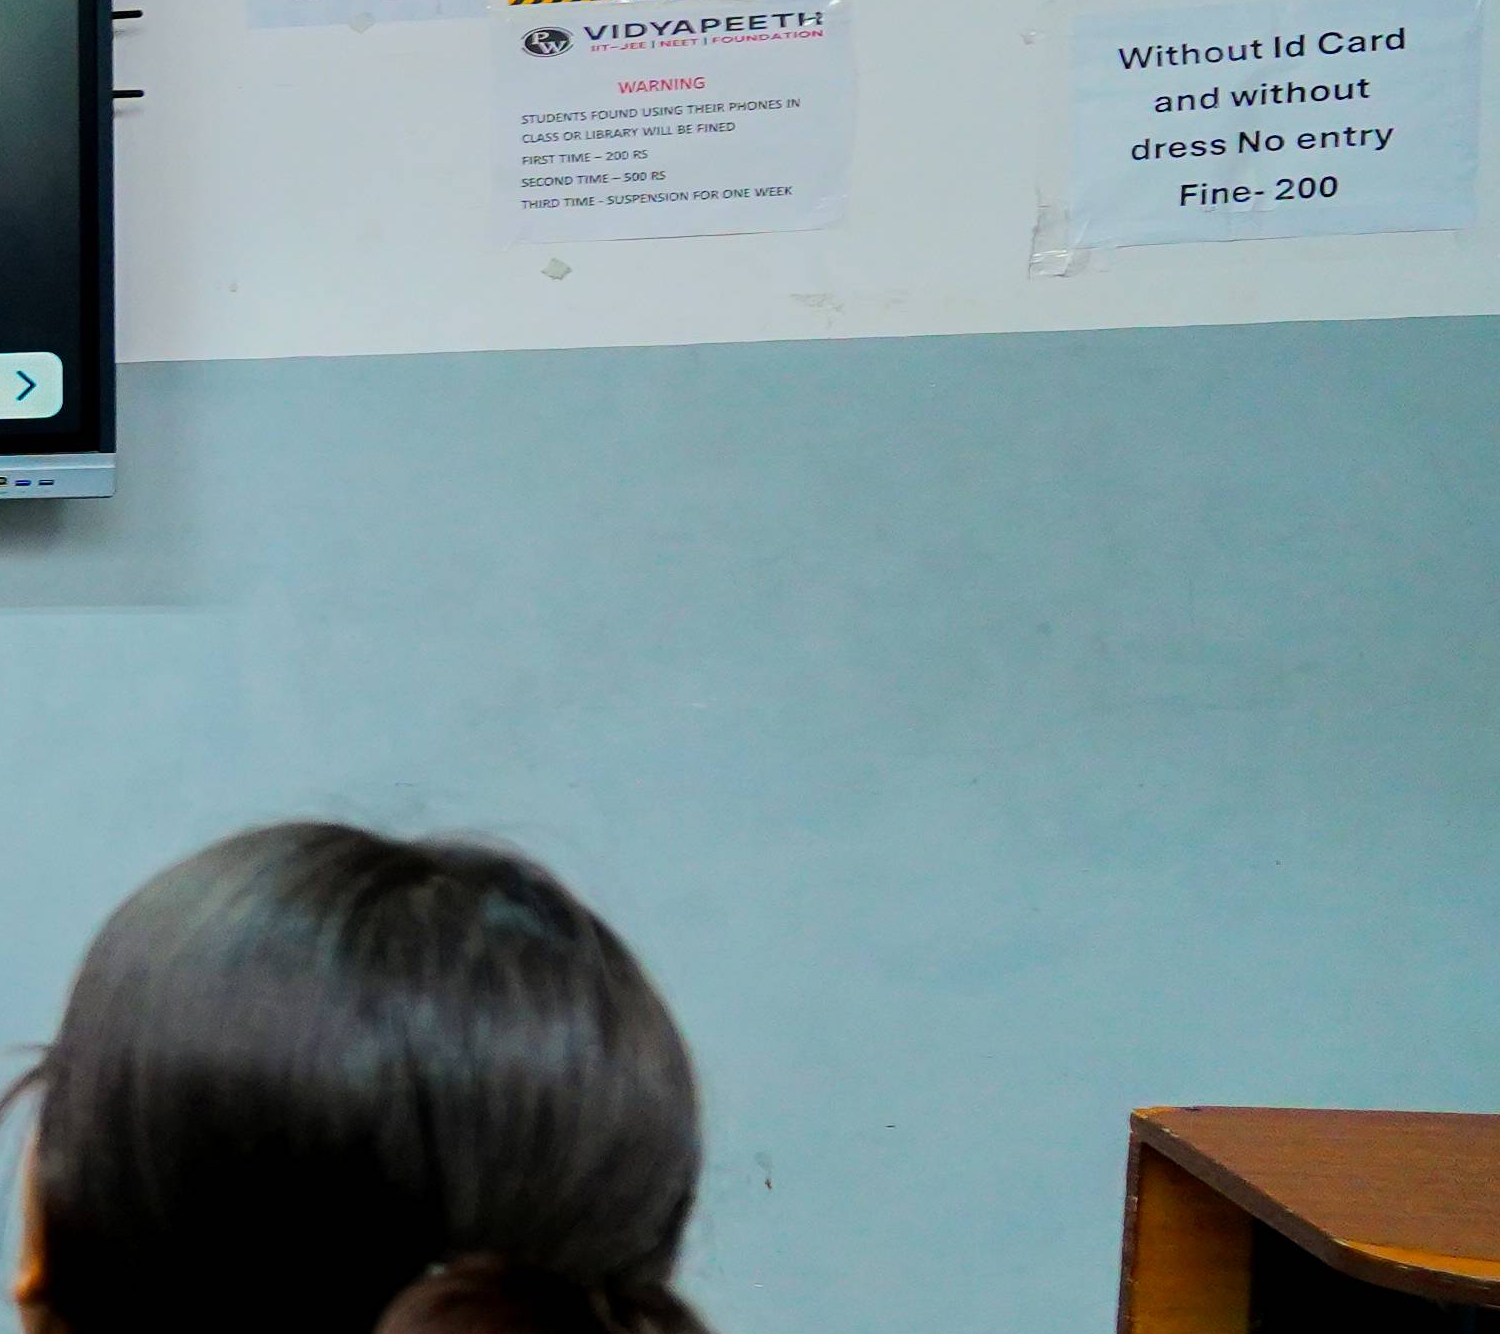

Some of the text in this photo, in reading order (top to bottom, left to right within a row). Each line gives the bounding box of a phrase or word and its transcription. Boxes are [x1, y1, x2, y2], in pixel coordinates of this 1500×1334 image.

[583, 11, 822, 40] VIDYAPEETH
[659, 38, 698, 47] NEET
[711, 29, 823, 43] FOUNDATION
[1118, 27, 1404, 69] Without Id Card
[618, 76, 705, 94] WARNING
[1154, 78, 1369, 112] and without
[521, 98, 800, 124] STUDENTS FOUND USING THEIR PHONES IN
[522, 121, 735, 143] CLASS OR LIBRARY WILL BE FINED
[1131, 126, 1394, 160] dress No entry
[521, 154, 556, 165] FIRST
[558, 152, 591, 163] TIME
[605, 150, 629, 161] 200
[632, 149, 648, 159] RS
[521, 175, 573, 187] SECOND
[576, 173, 608, 184] TIME
[623, 171, 647, 182] 500
[651, 170, 666, 180] RS
[1180, 175, 1337, 206] Fine- 200
[520, 198, 560, 209] THIRD
[563, 196, 595, 206] TIME
[606, 191, 688, 205] SUSPENSION
[692, 190, 719, 200] FOR
[722, 188, 750, 199] ONE
[754, 186, 792, 197] WEEK
